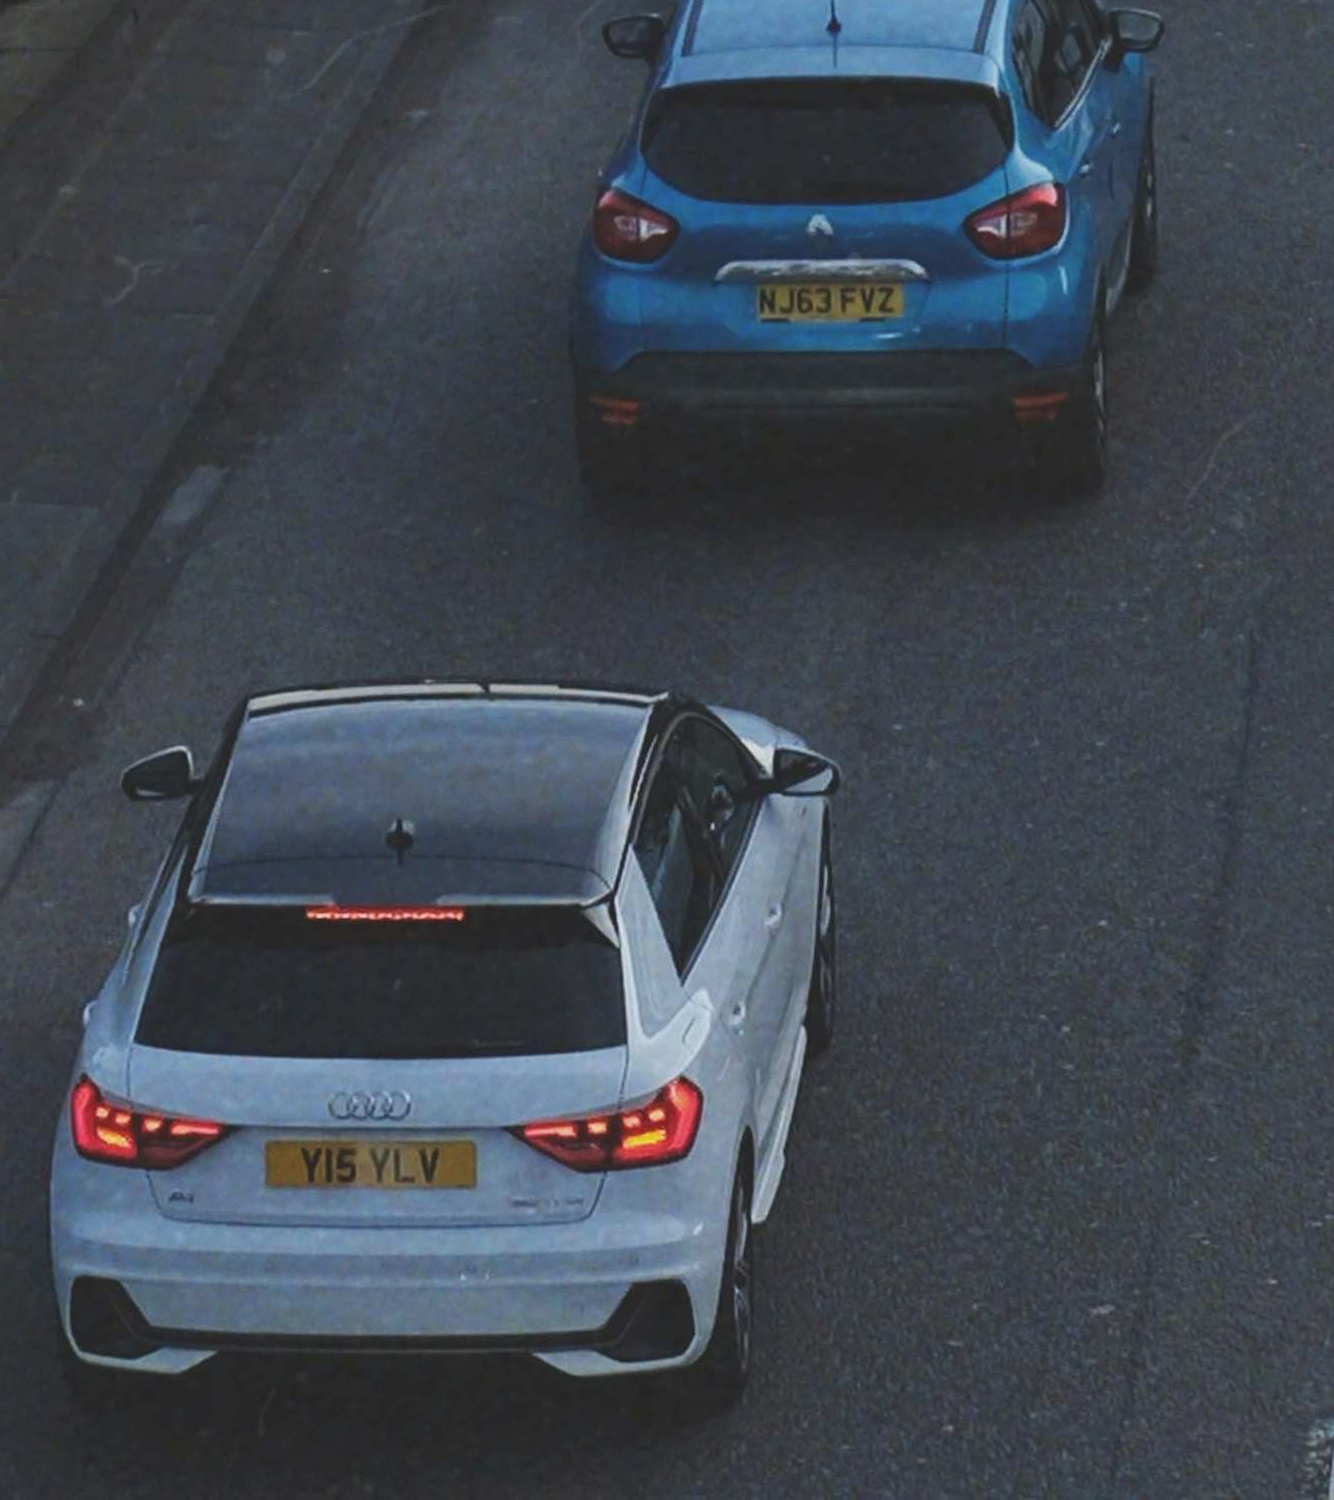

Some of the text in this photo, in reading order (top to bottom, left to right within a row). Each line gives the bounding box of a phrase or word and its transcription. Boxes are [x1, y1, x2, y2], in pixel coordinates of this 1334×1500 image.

[759, 287, 896, 315] NJ63 FVZ
[300, 1144, 442, 1186] Y15 YLV
